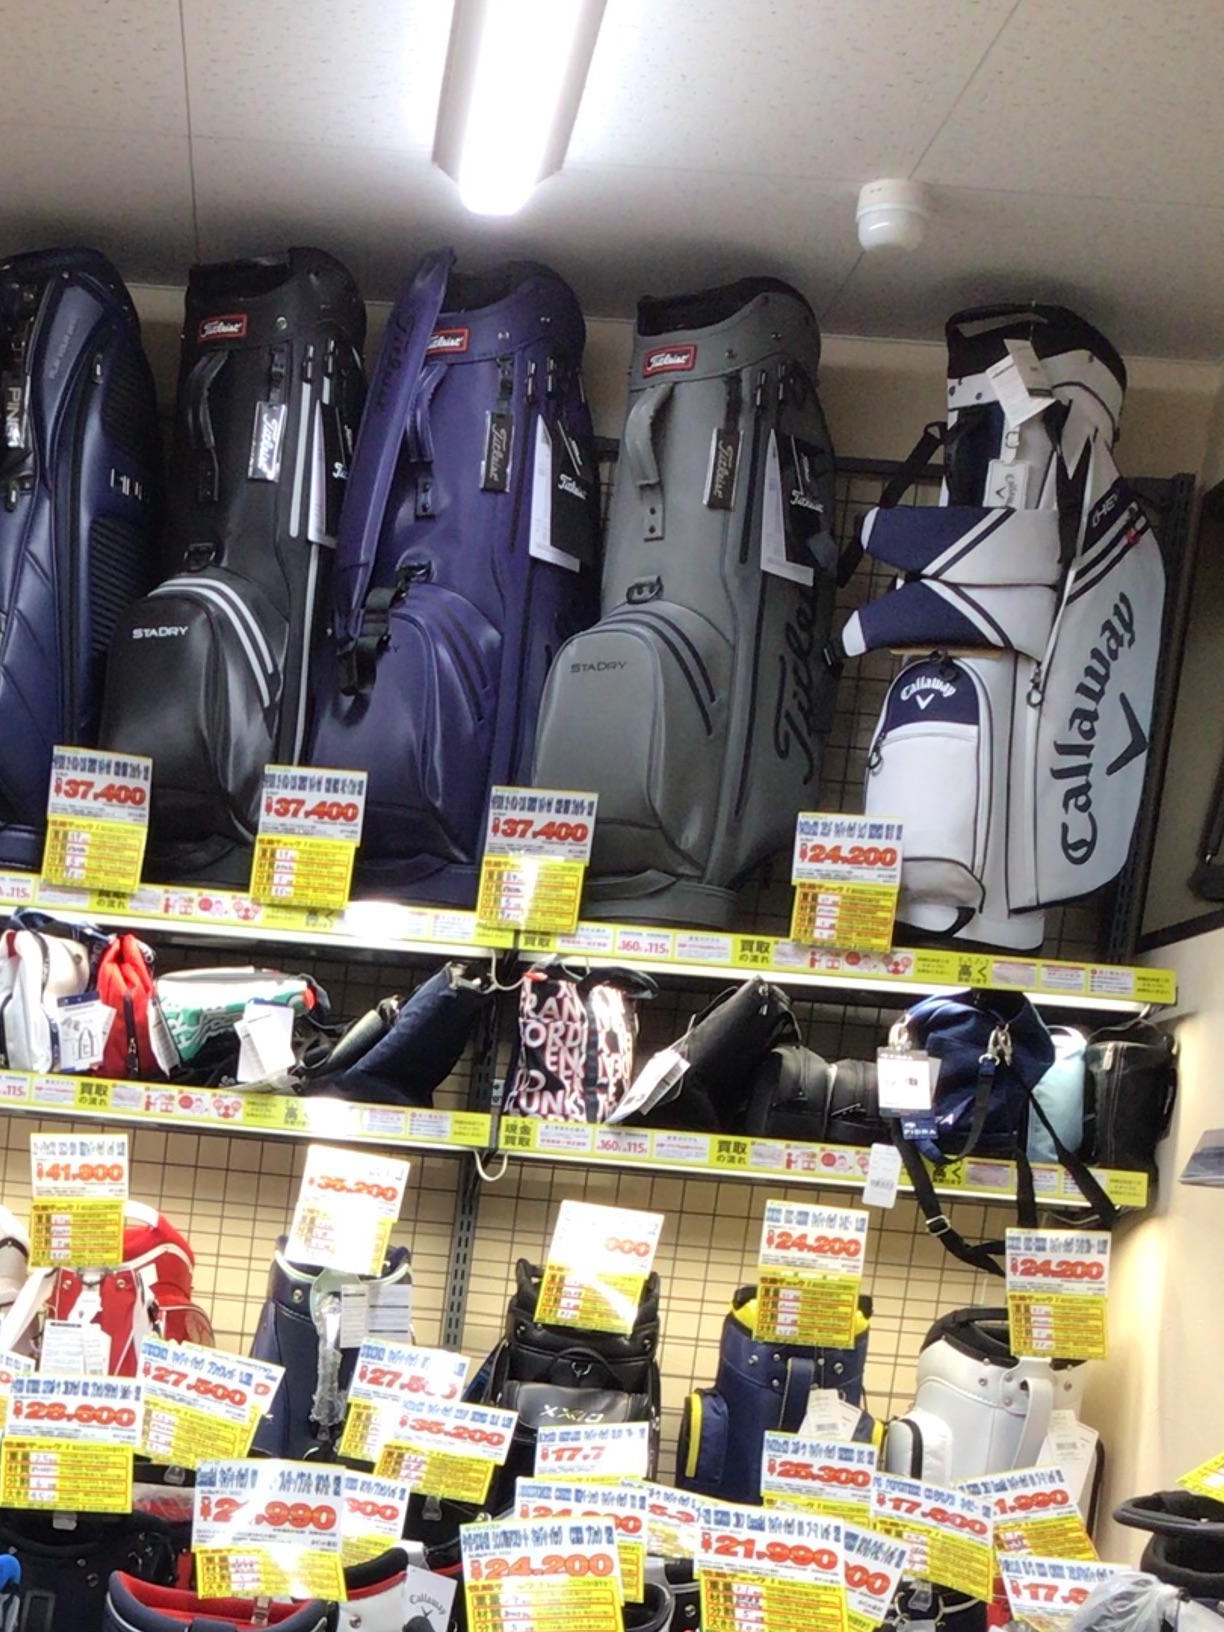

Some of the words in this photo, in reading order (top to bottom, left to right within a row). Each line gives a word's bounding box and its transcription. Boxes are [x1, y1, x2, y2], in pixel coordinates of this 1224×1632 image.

[132, 625, 189, 640] STADRY
[570, 660, 627, 674] STADRY
[900, 674, 957, 701] Callaway
[1051, 592, 1136, 866] Callaway
[739, 938, 771, 954] 買取
[79, 1081, 109, 1097] 買取
[716, 1139, 748, 1154] 買取
[199, 1495, 338, 1531] ¥2,990
[469, 1553, 614, 1580] ¥24,200
[408, 1592, 448, 1616] Callaway
